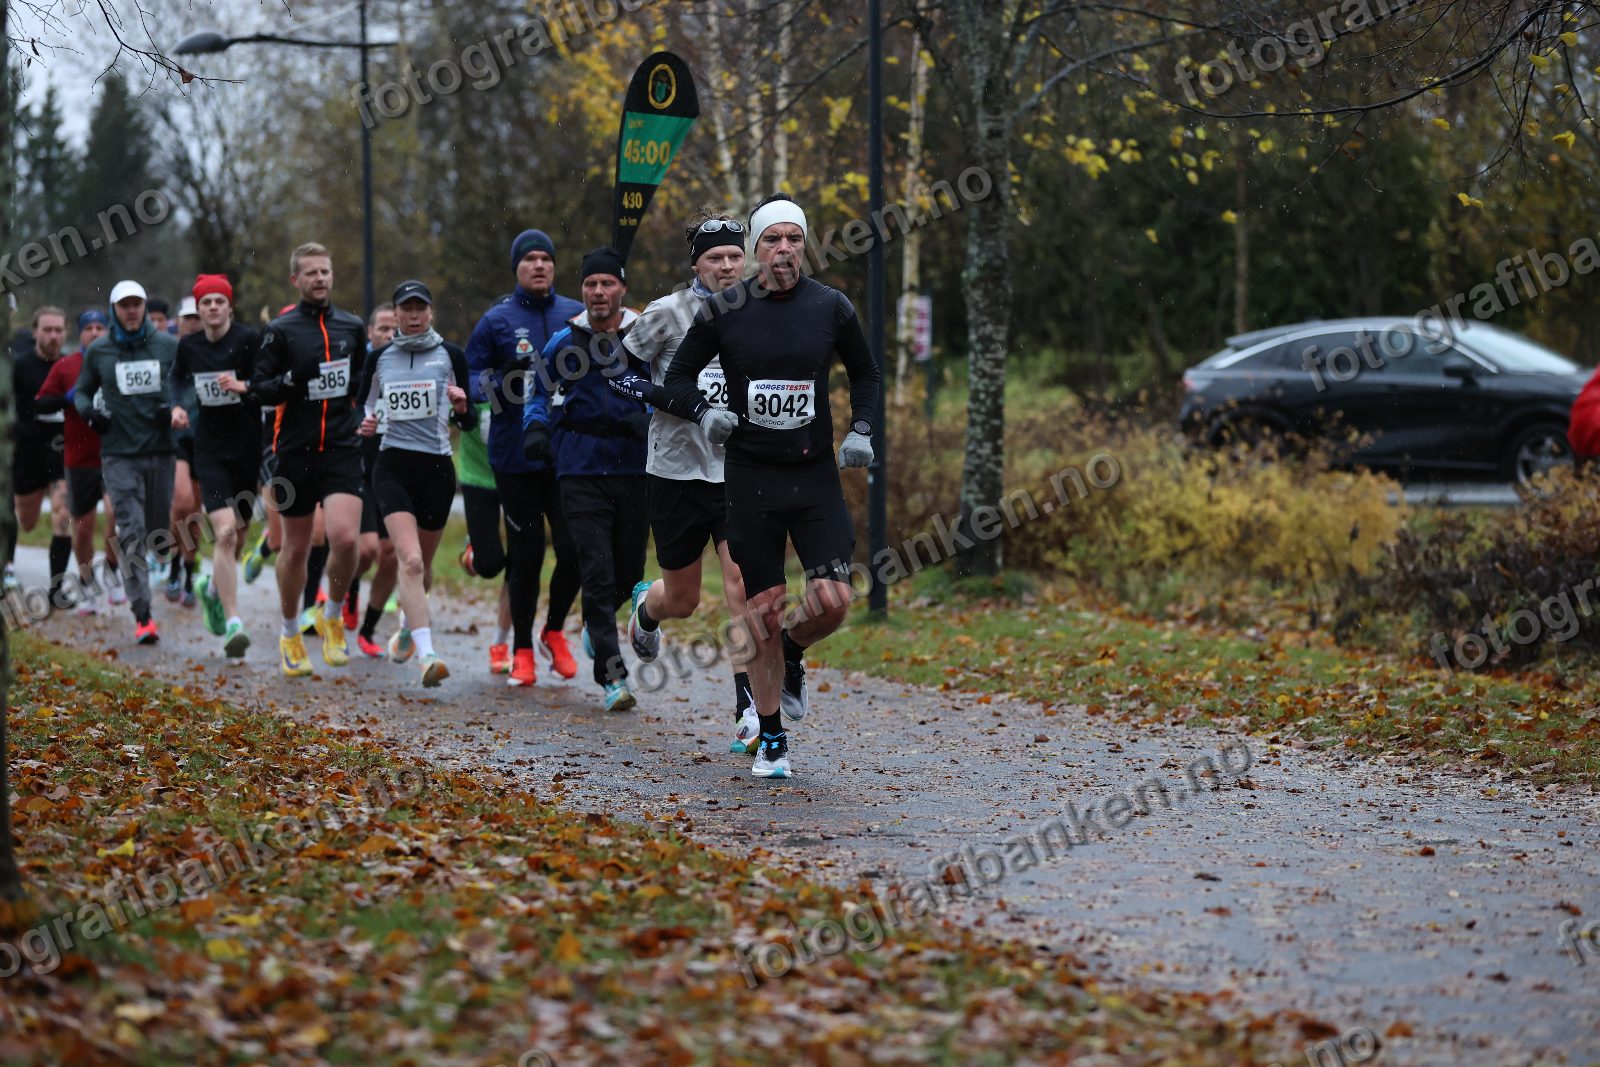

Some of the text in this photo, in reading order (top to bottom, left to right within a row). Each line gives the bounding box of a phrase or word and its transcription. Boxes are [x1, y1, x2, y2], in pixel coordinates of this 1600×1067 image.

[624, 139, 671, 165] 45:00
[125, 371, 152, 387] 562
[318, 370, 346, 390] 385
[754, 383, 811, 391] NORGESTESTEN
[389, 390, 430, 410] 9361
[753, 393, 809, 417] 3042
